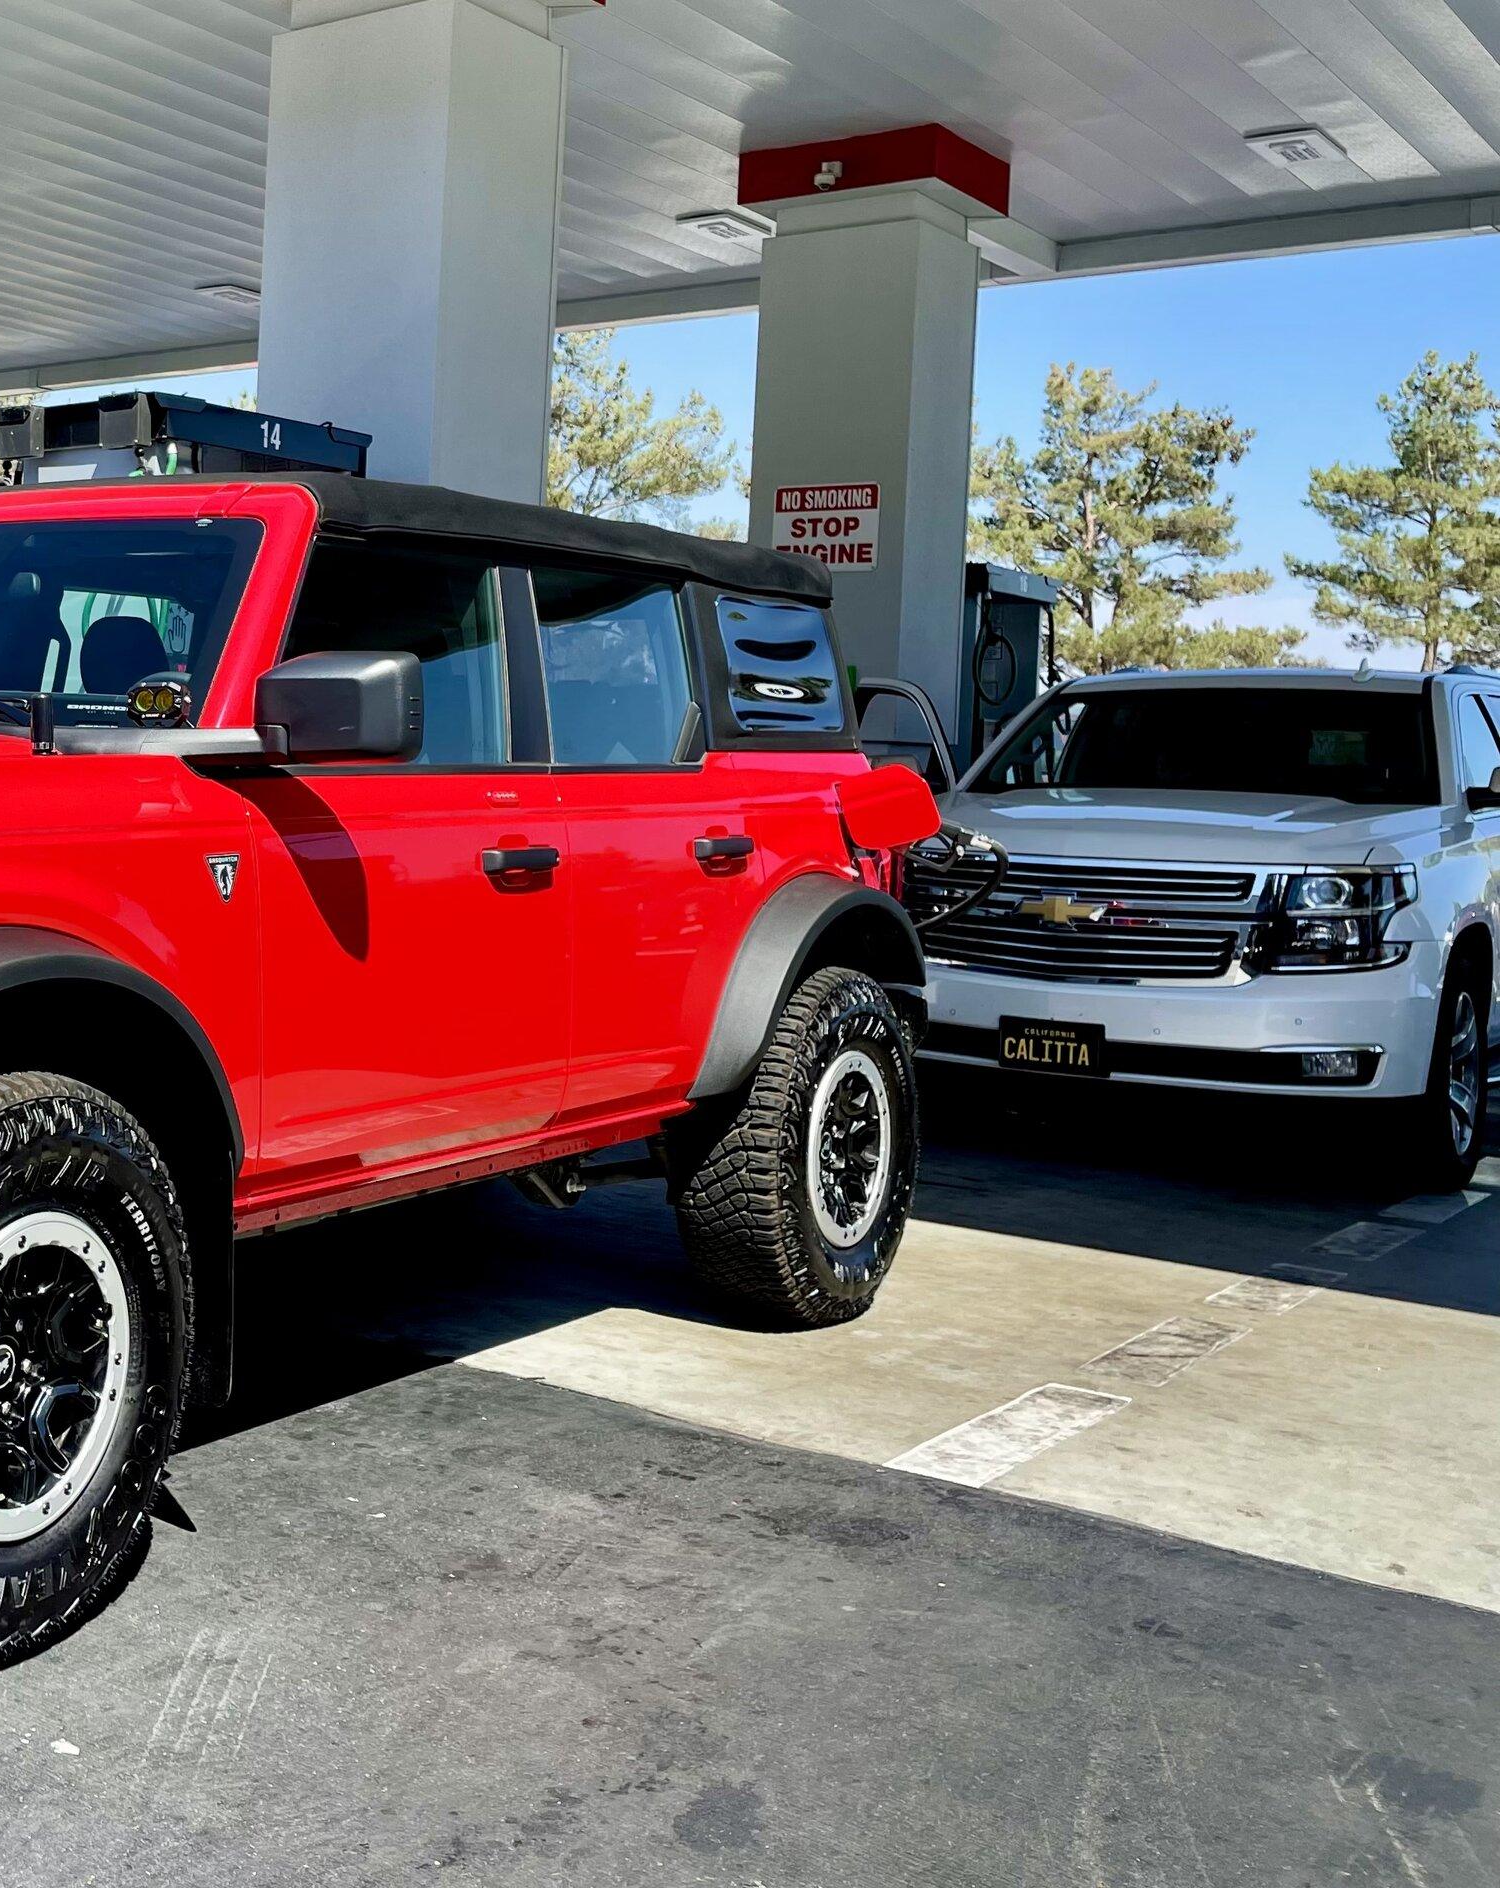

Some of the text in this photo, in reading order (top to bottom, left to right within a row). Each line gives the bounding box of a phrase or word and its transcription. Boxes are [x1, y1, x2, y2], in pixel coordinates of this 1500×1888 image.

[260, 420, 281, 450] 14
[782, 488, 872, 510] NO SMOKING
[791, 517, 860, 538] STOP
[776, 543, 873, 564] GINE
[1024, 1028, 1076, 1038] CALIFORNIA
[1004, 1037, 1090, 1066] CALITTA
[120, 1191, 166, 1292] TERRITORY
